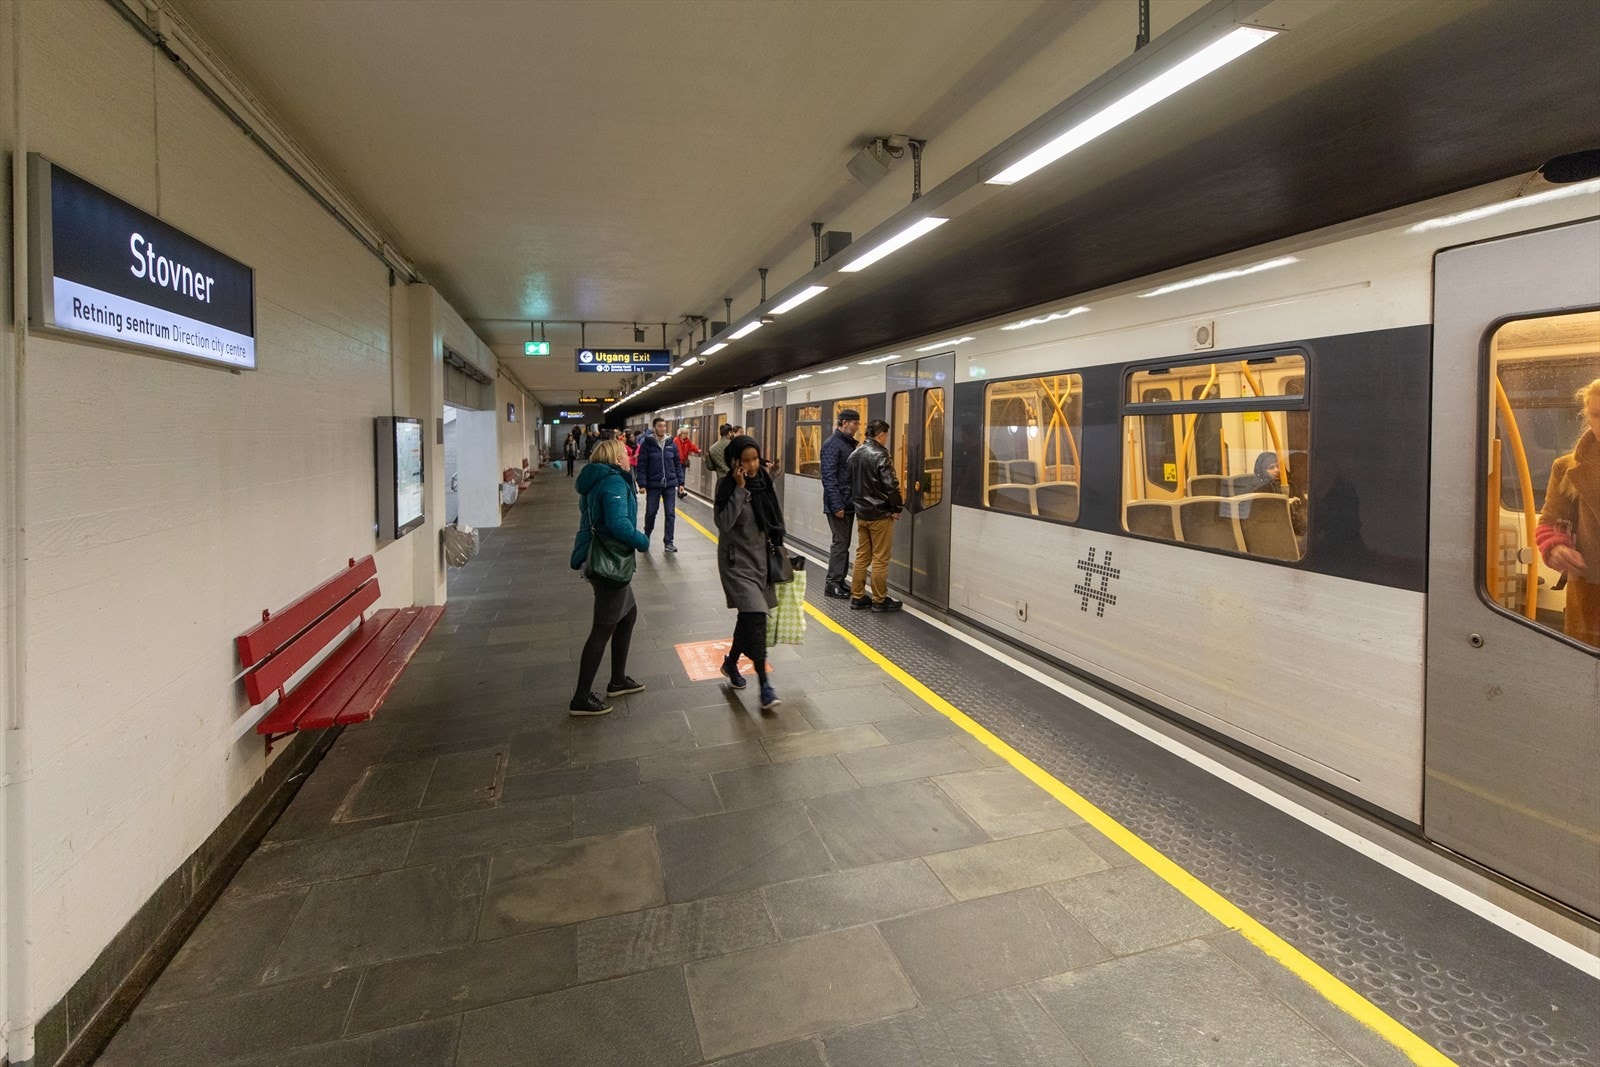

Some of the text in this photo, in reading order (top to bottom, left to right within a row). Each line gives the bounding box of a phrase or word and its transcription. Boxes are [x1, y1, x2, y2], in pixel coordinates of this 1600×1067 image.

[130, 232, 214, 303] Stovner
[73, 297, 246, 359] Retning sentrum Direction city centre
[595, 352, 651, 363] Utgang Exit
